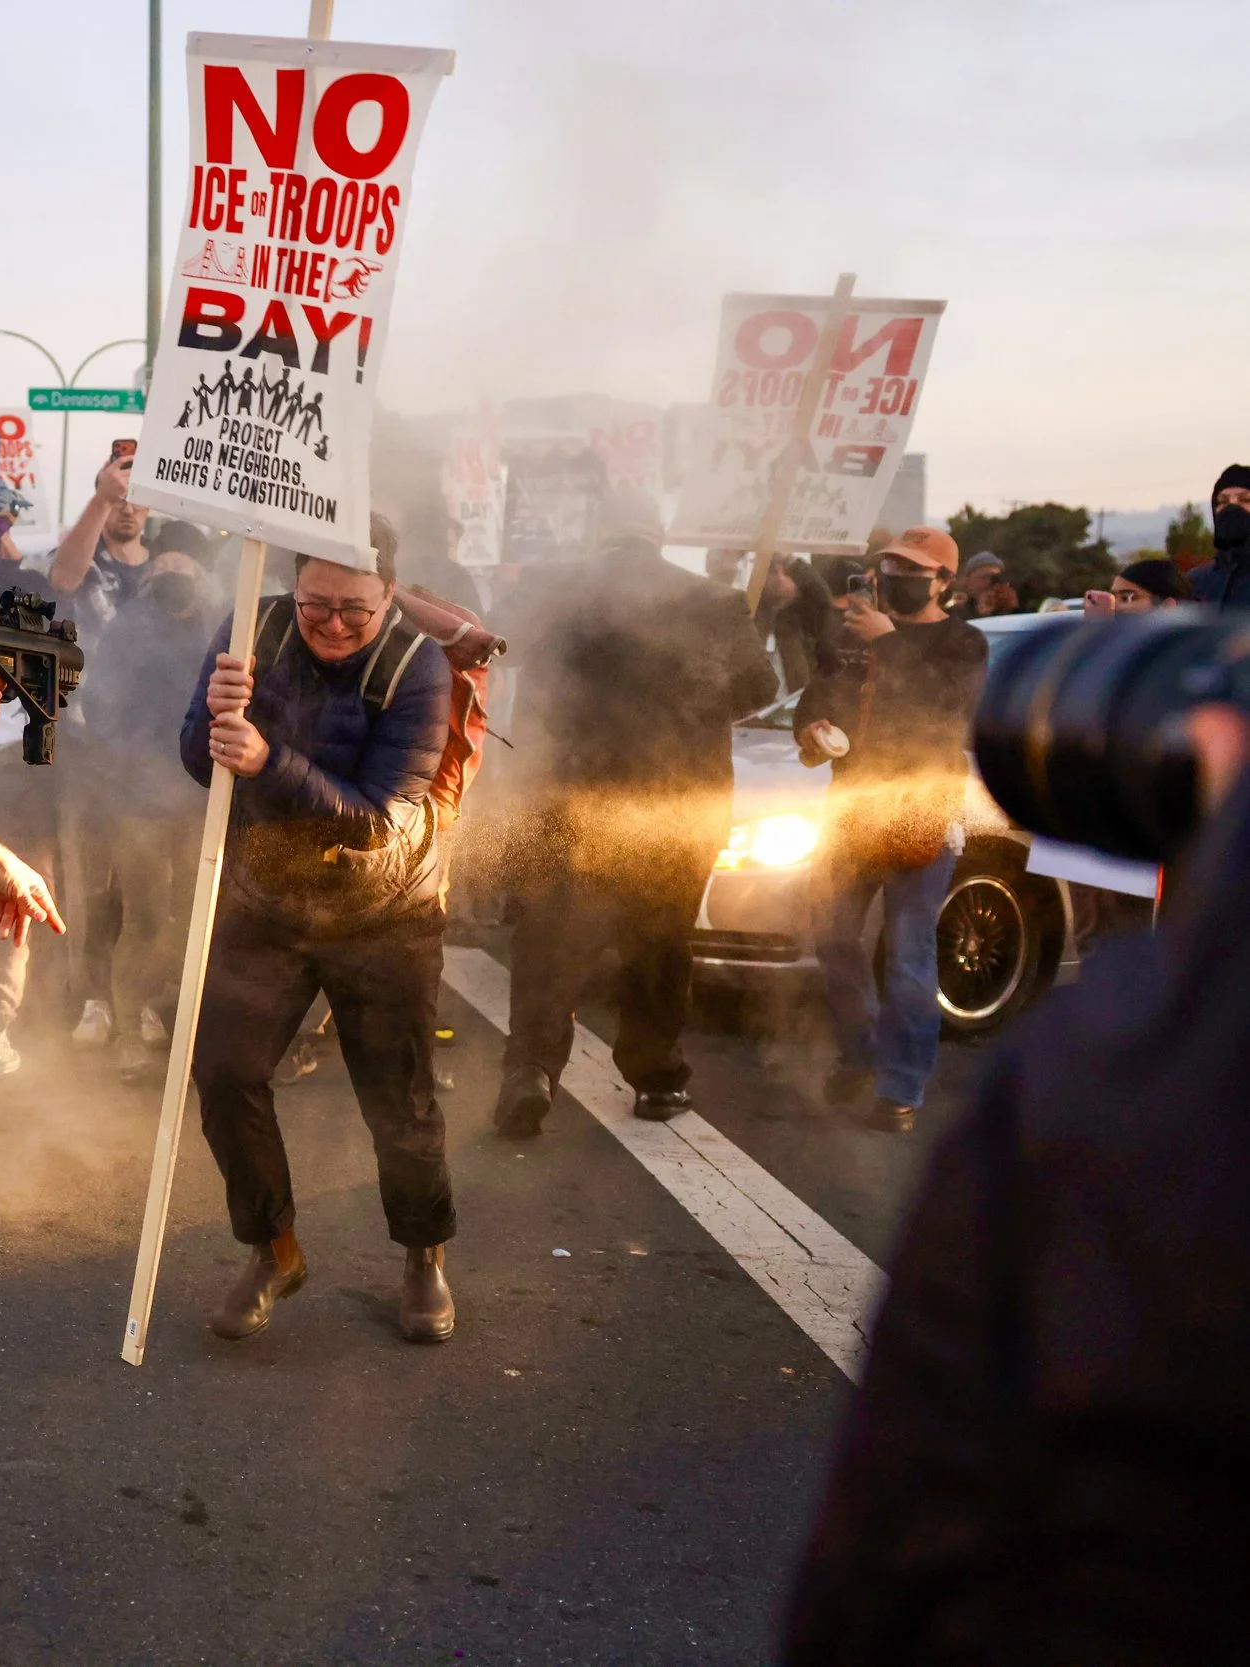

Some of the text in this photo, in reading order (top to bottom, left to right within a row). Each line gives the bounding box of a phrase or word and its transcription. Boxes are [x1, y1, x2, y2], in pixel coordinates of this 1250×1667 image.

[204, 64, 410, 180] NO
[188, 165, 400, 256] ICE OR TROOPS
[250, 244, 326, 298] IN THE
[177, 286, 373, 384] BAY!
[51, 391, 119, 407] Dennison
[184, 437, 213, 463] OUR
[219, 417, 284, 454] PROTECT
[155, 457, 337, 523] RIGHTS & CONSTITUTION
